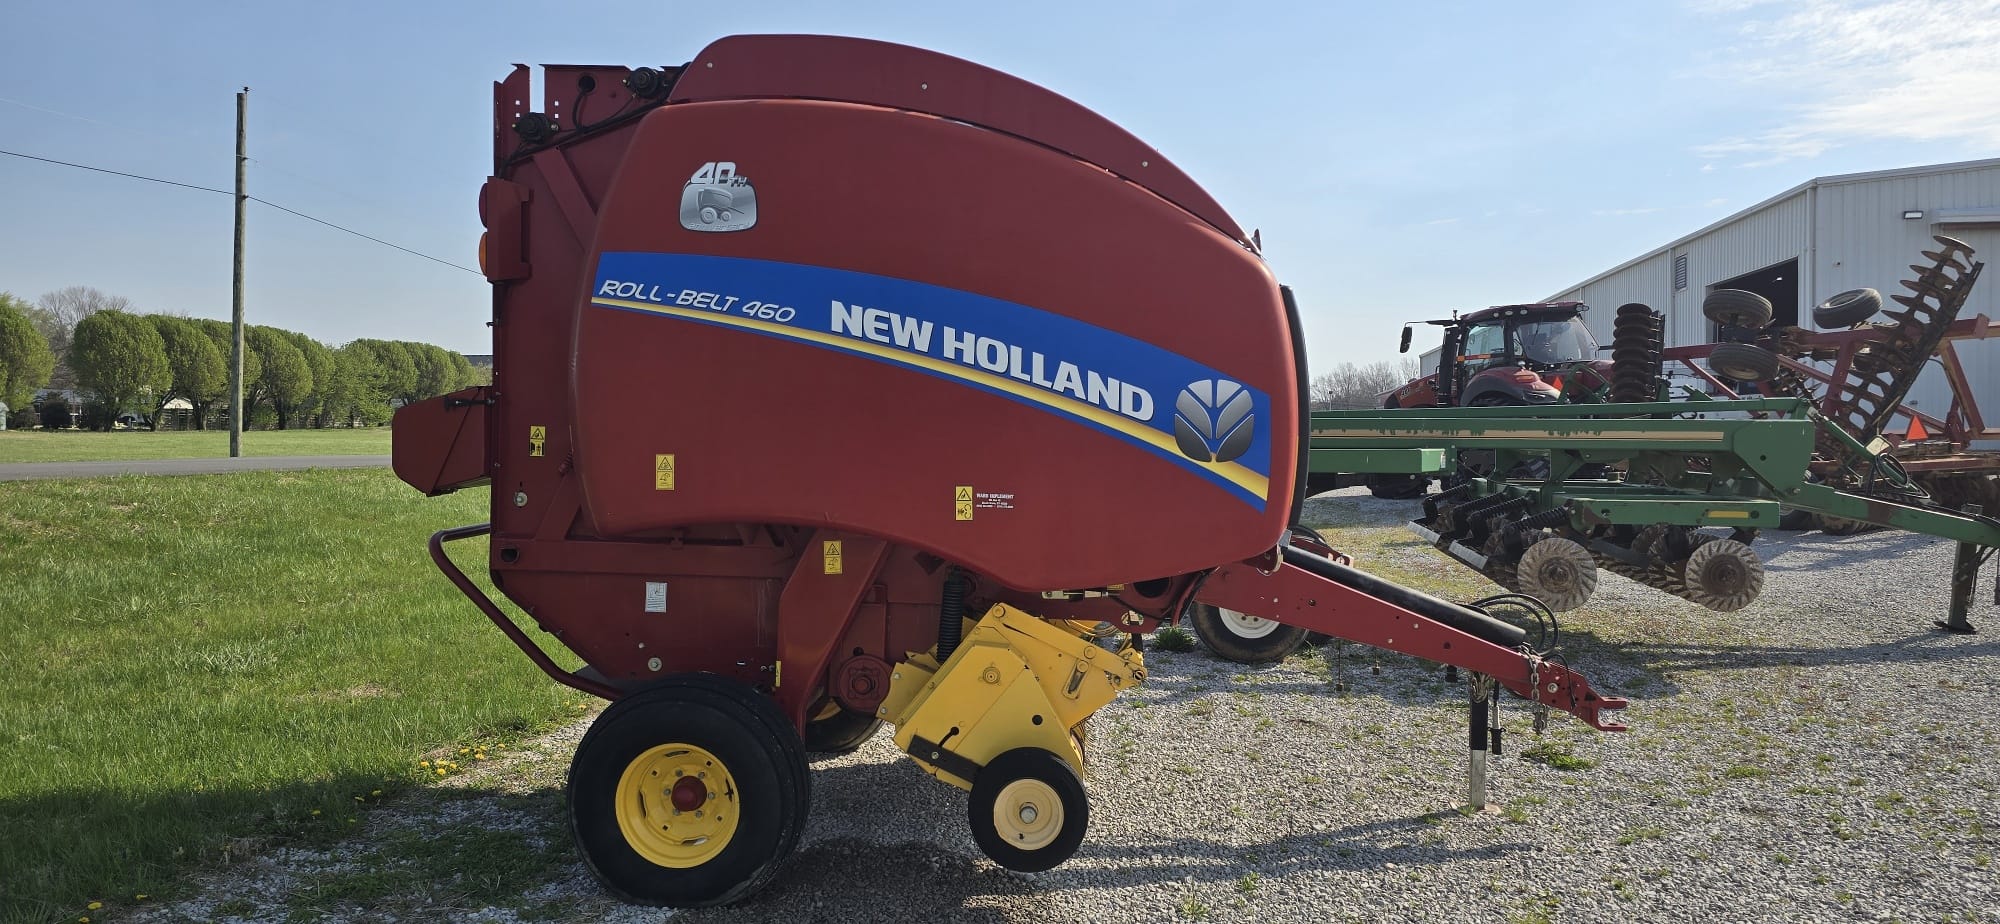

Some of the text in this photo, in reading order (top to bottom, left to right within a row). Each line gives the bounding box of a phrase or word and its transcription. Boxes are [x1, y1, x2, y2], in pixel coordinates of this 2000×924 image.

[598, 279, 796, 323] ROLL-BELT 460
[830, 300, 1154, 422] NEW HOLLAND
